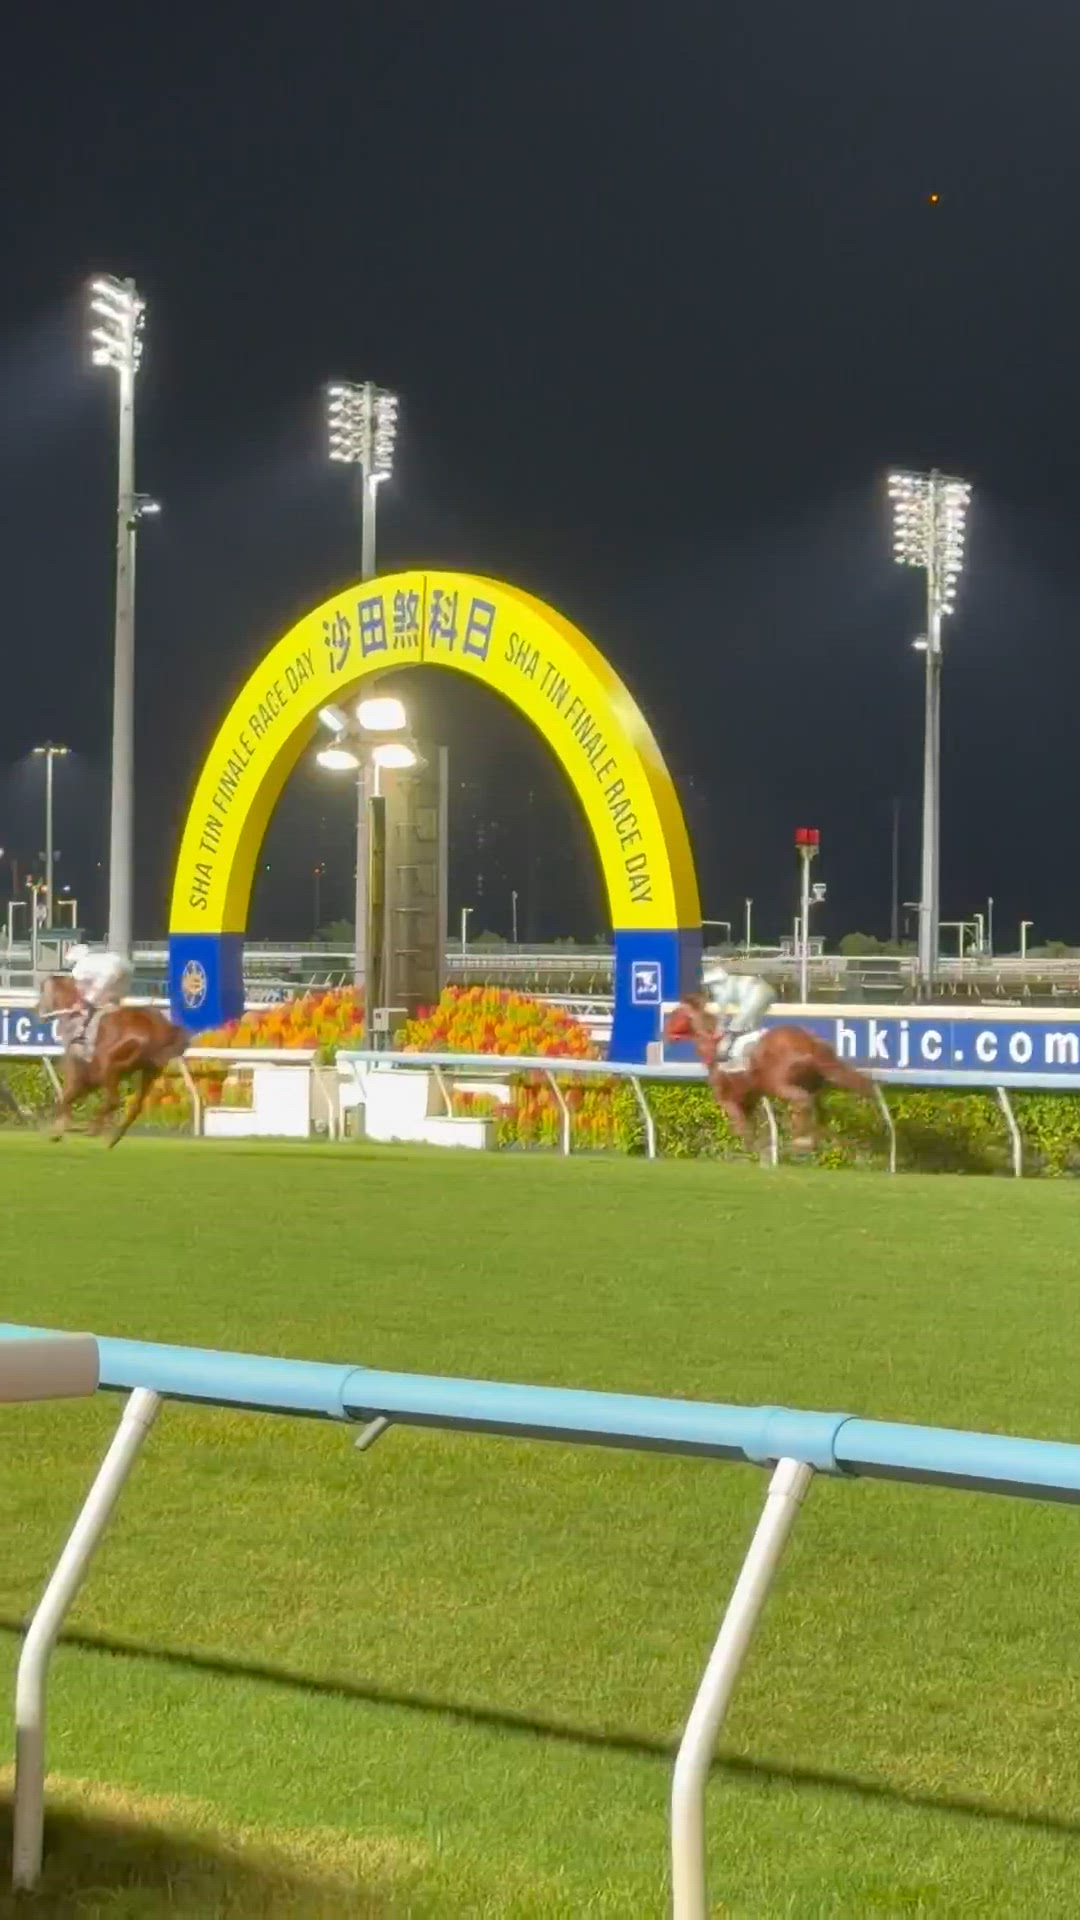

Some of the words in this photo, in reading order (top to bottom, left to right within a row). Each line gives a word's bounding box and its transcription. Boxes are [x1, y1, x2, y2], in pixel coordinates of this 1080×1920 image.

[322, 589, 496, 674] 沙田煞科日
[288, 648, 315, 694] DAY
[249, 684, 288, 742] RACE
[212, 735, 256, 814] FINALE
[504, 632, 539, 681] SHA
[538, 661, 571, 710] TIN
[564, 695, 616, 784] FINALE
[605, 778, 643, 851] RACE
[625, 853, 653, 903] DAY
[200, 814, 224, 855] TIN
[189, 863, 213, 911] SHA
[835, 1019, 1080, 1067] hkjc.com
